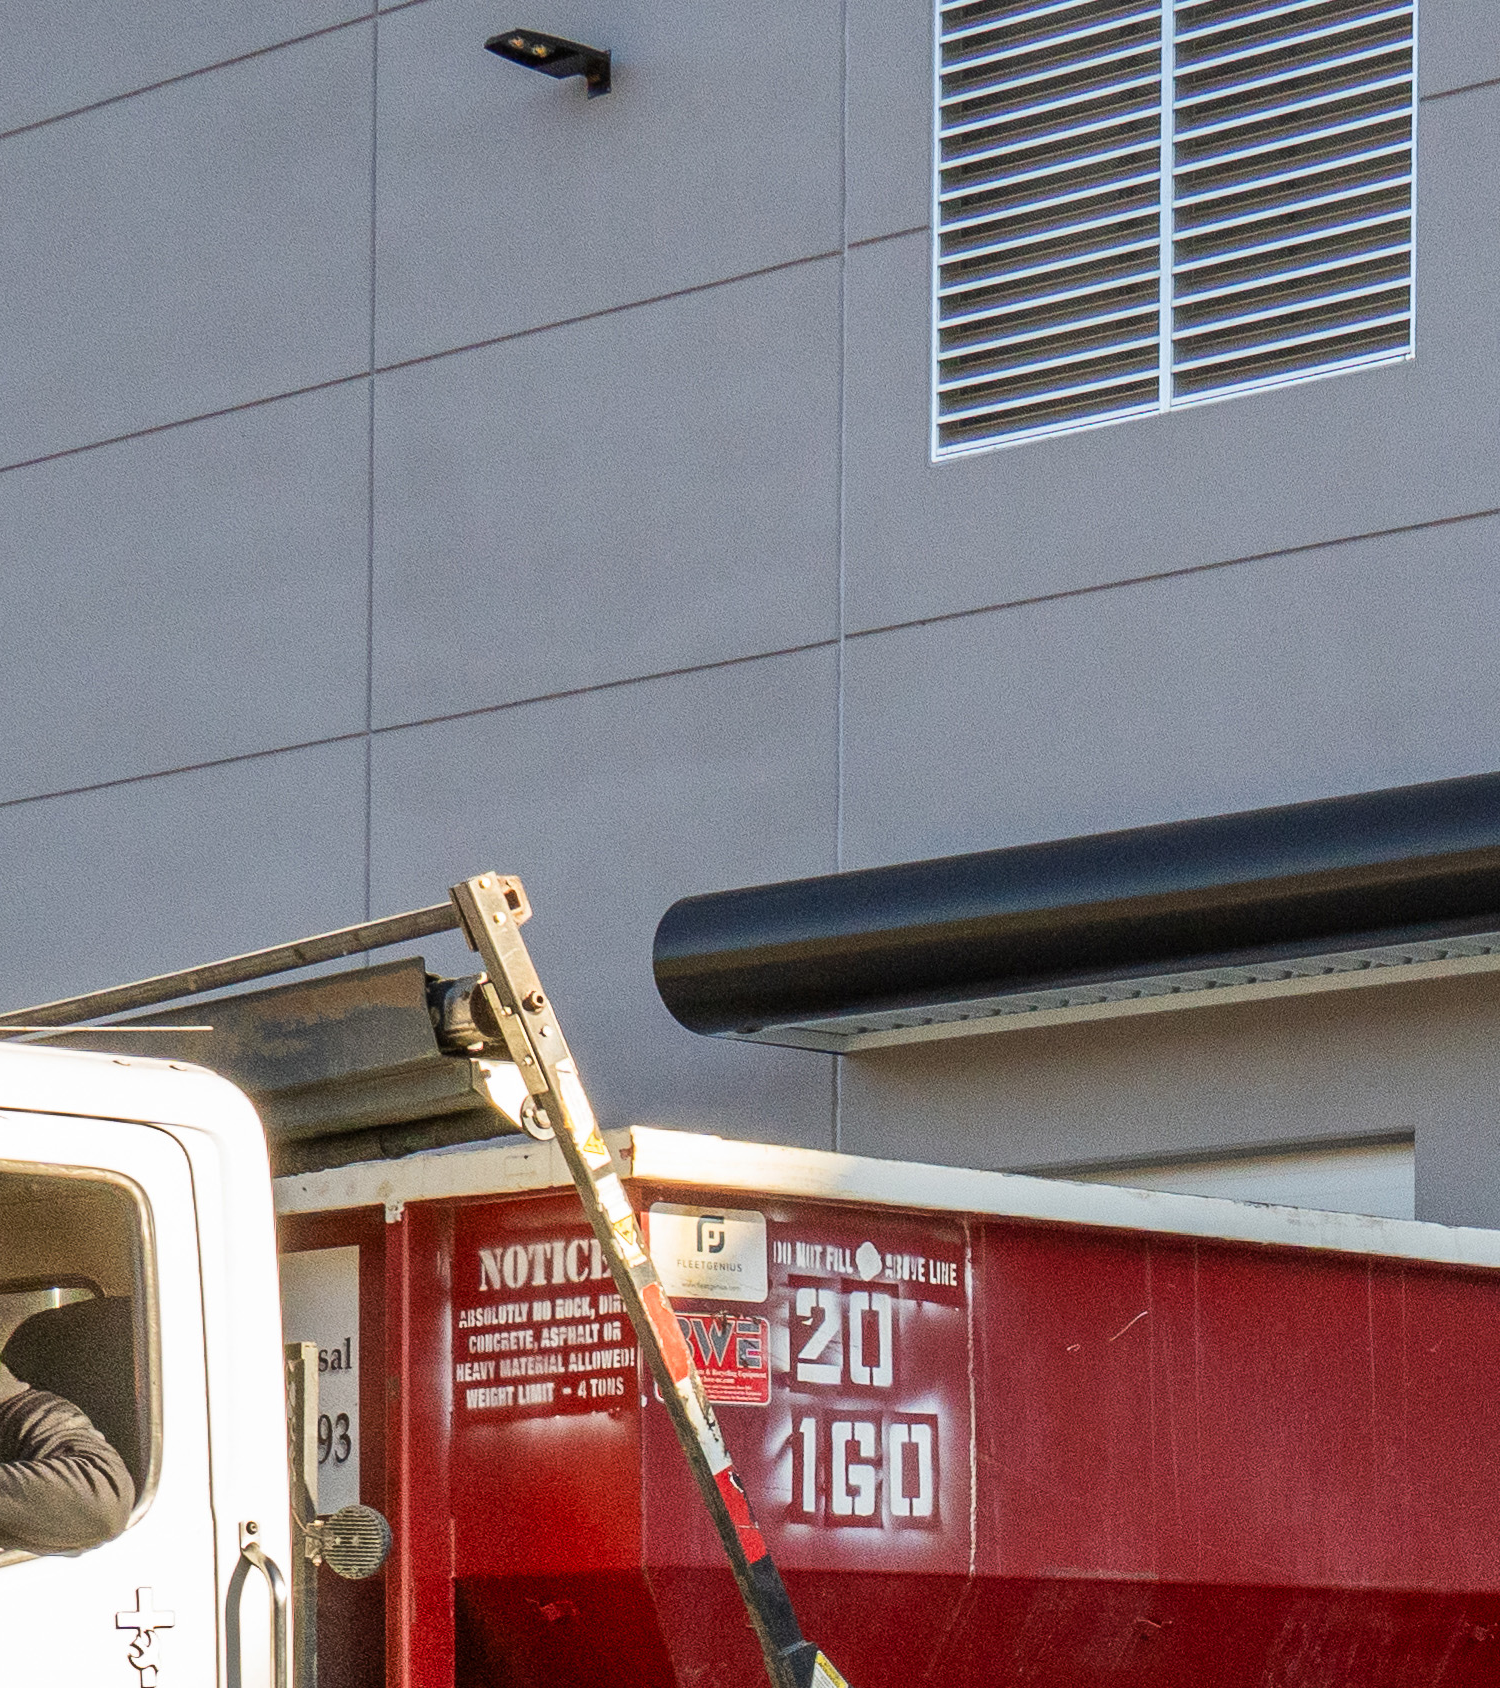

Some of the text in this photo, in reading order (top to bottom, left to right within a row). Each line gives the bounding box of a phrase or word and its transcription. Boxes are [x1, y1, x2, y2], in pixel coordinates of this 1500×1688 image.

[677, 1260, 743, 1273] FLEETGENIUS
[826, 1245, 853, 1274] FILL
[929, 1259, 957, 1286] LINE
[532, 1299, 552, 1322] NO
[540, 1323, 601, 1349] ASPHALT
[603, 1320, 622, 1342] OR
[796, 1287, 893, 1387] 20
[456, 1347, 635, 1383] HEAVY MATERIAL ALLOWED!
[466, 1386, 515, 1410] WEIGHT
[518, 1382, 555, 1406] LIMIT
[589, 1376, 625, 1398] TONS
